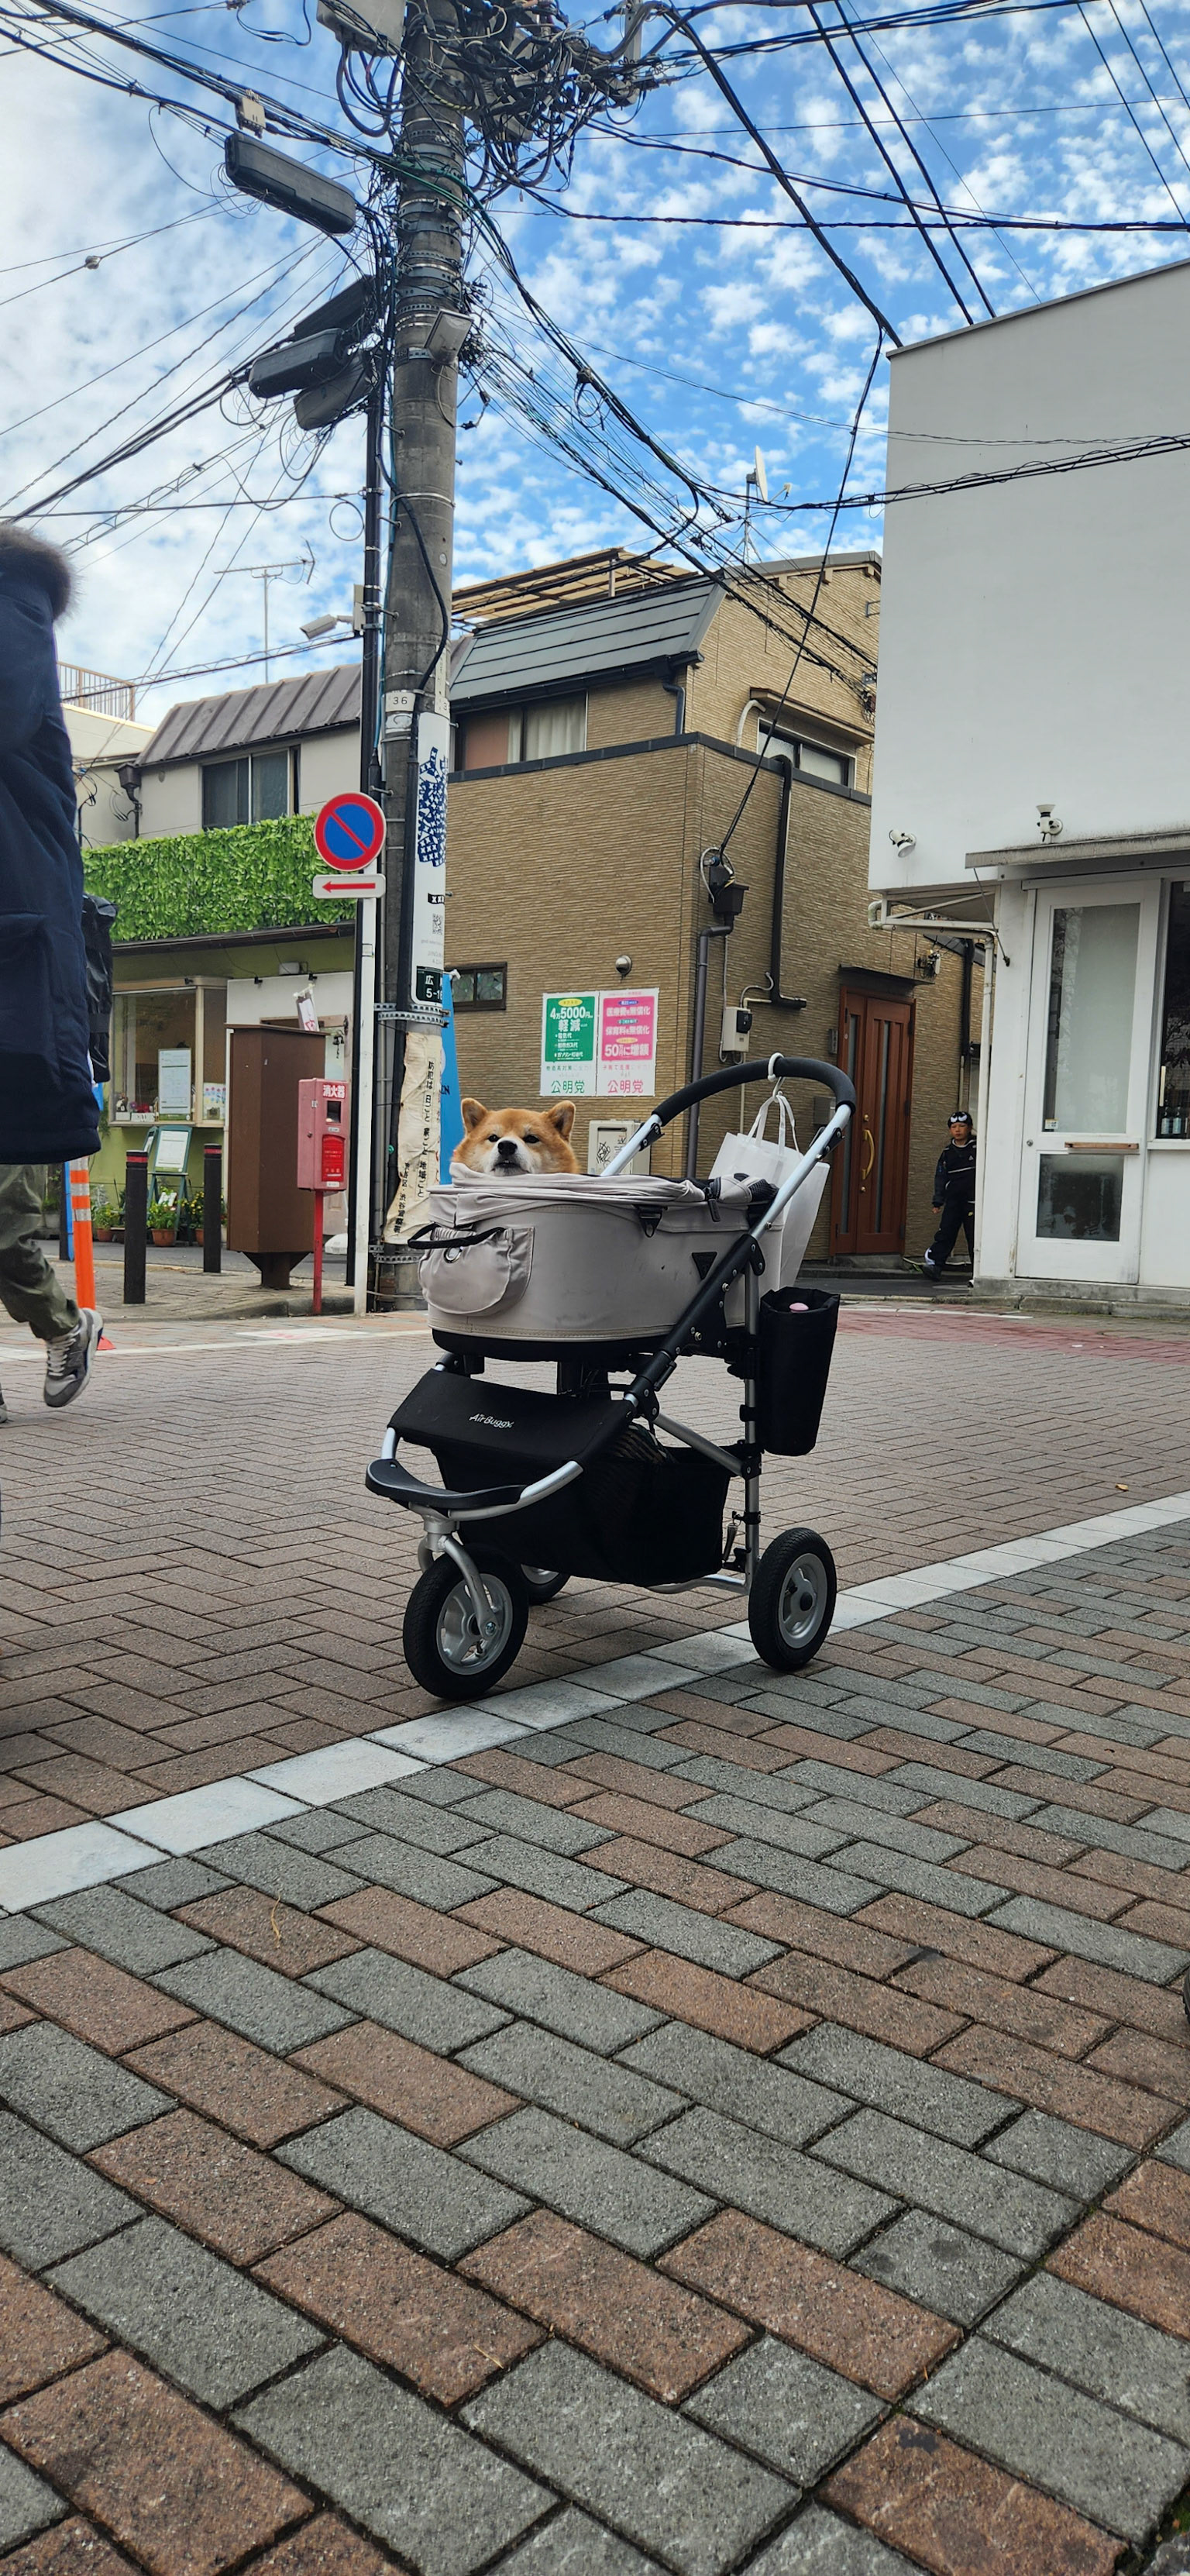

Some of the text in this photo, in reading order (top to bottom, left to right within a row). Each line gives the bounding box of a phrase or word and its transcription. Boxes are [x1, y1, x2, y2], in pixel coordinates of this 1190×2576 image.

[393, 696, 408, 705] 36
[424, 974, 443, 986] 広
[558, 1018, 581, 1032] 軽減
[322, 1084, 346, 1098] 消火器
[551, 1080, 585, 1093] 公明党
[607, 1079, 644, 1093] 公明党
[469, 1414, 514, 1428] AirBuggy
